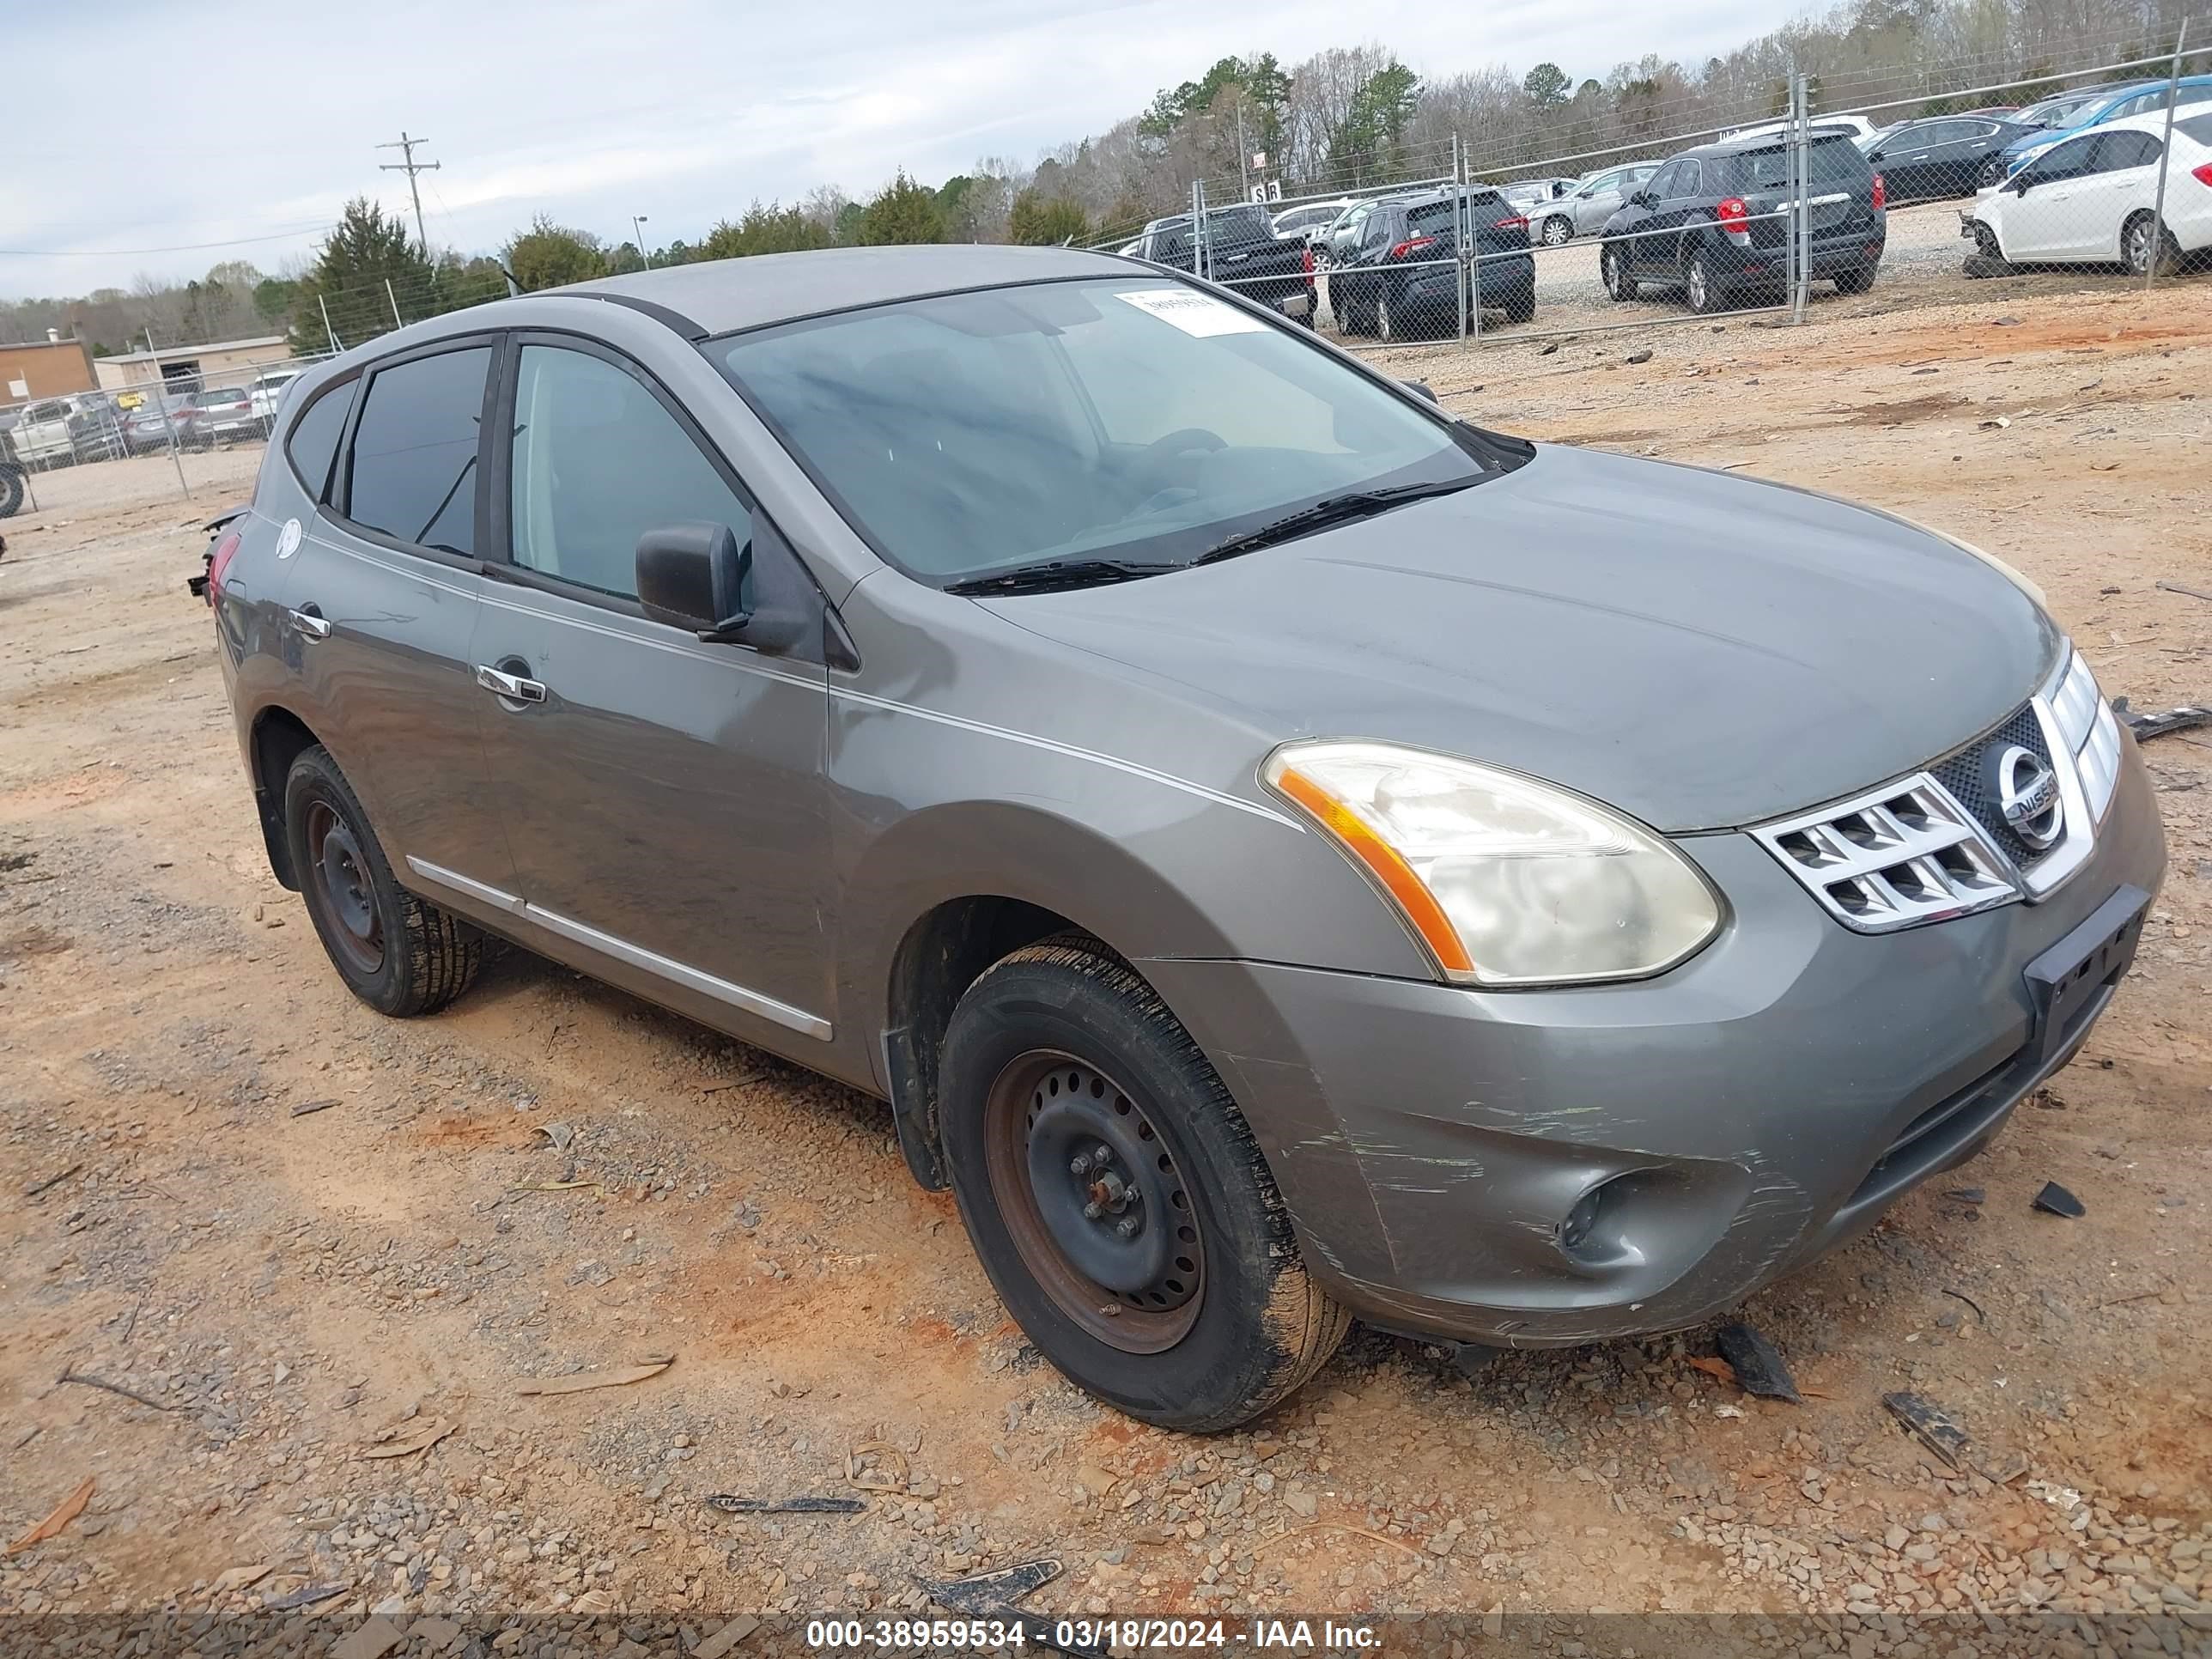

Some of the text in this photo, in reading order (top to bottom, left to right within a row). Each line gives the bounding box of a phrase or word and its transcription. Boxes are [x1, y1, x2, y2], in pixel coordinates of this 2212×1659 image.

[1256, 185, 1278, 203] S R
[2017, 780, 2059, 817] NISSA
